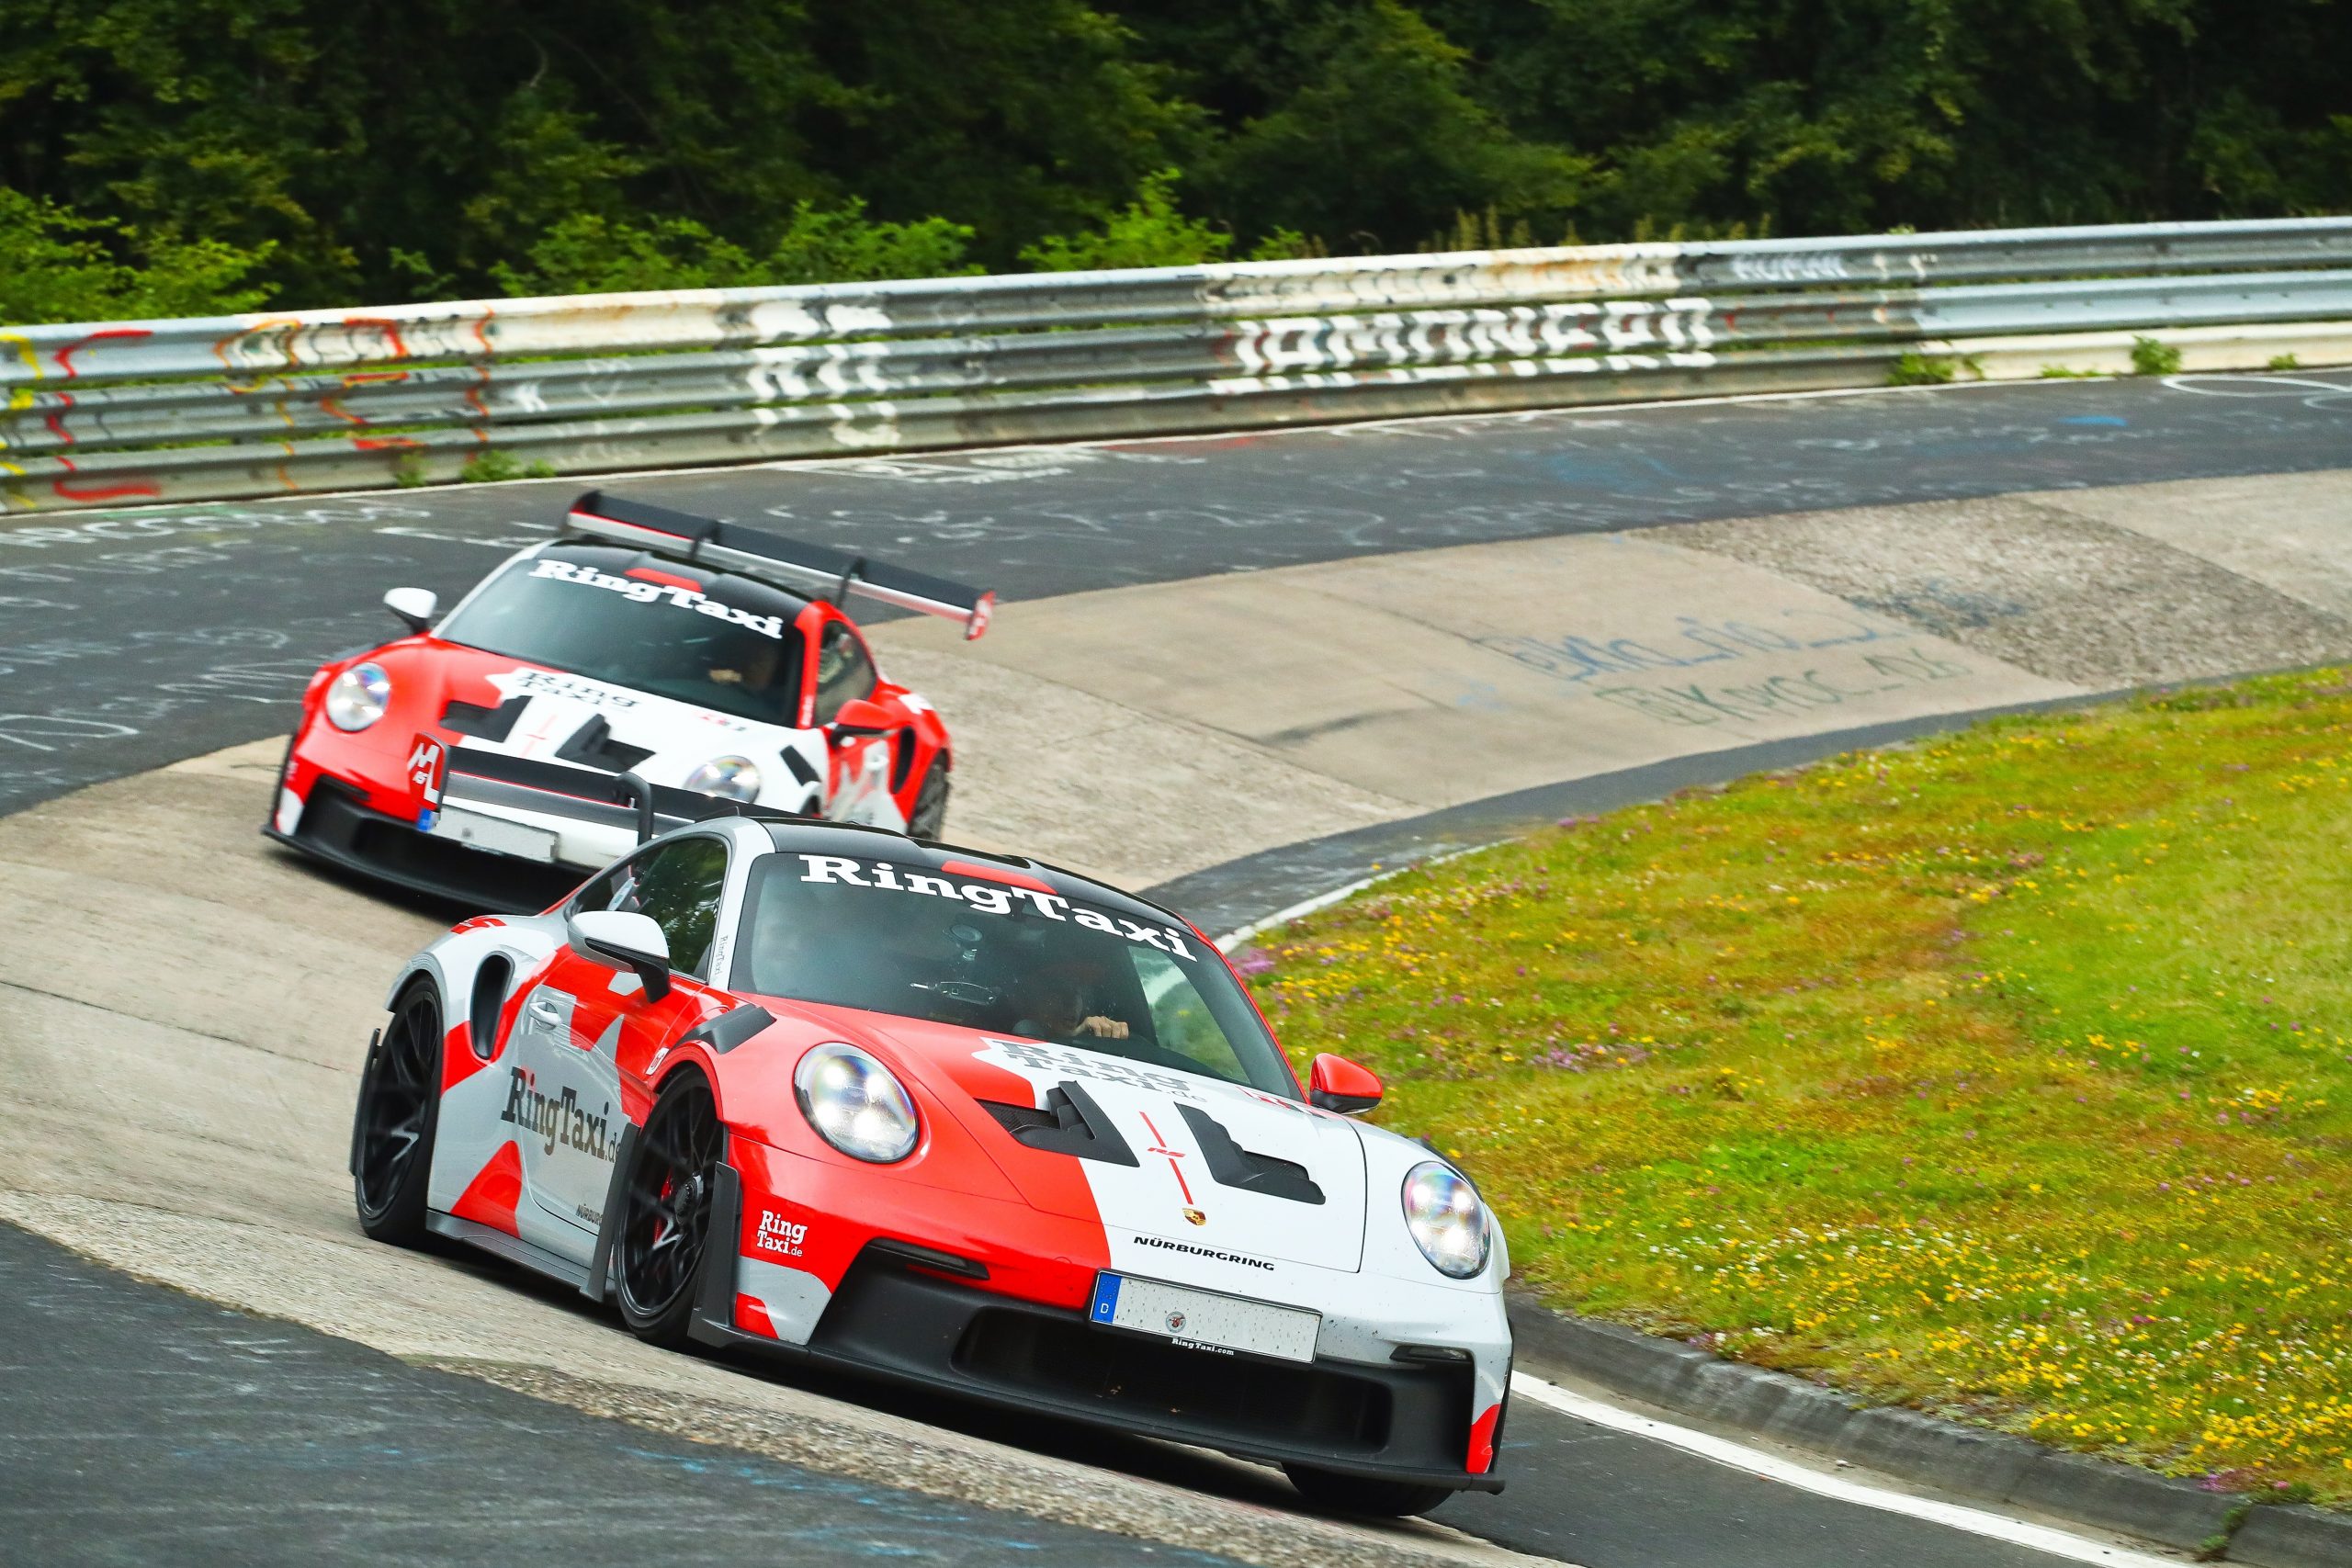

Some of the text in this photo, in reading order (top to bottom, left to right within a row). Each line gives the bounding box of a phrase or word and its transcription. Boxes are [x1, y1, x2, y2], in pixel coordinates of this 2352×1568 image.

[529, 559, 785, 639] RingTaxi
[522, 672, 639, 706] Ring
[798, 854, 1198, 962] RingTaxi
[992, 1041, 1191, 1090] Ring
[757, 1230, 803, 1258] Taxi.de
[759, 1210, 808, 1245] Ring
[1133, 1236, 1275, 1271] NÜRBURGRING
[1100, 1303, 1109, 1314] D
